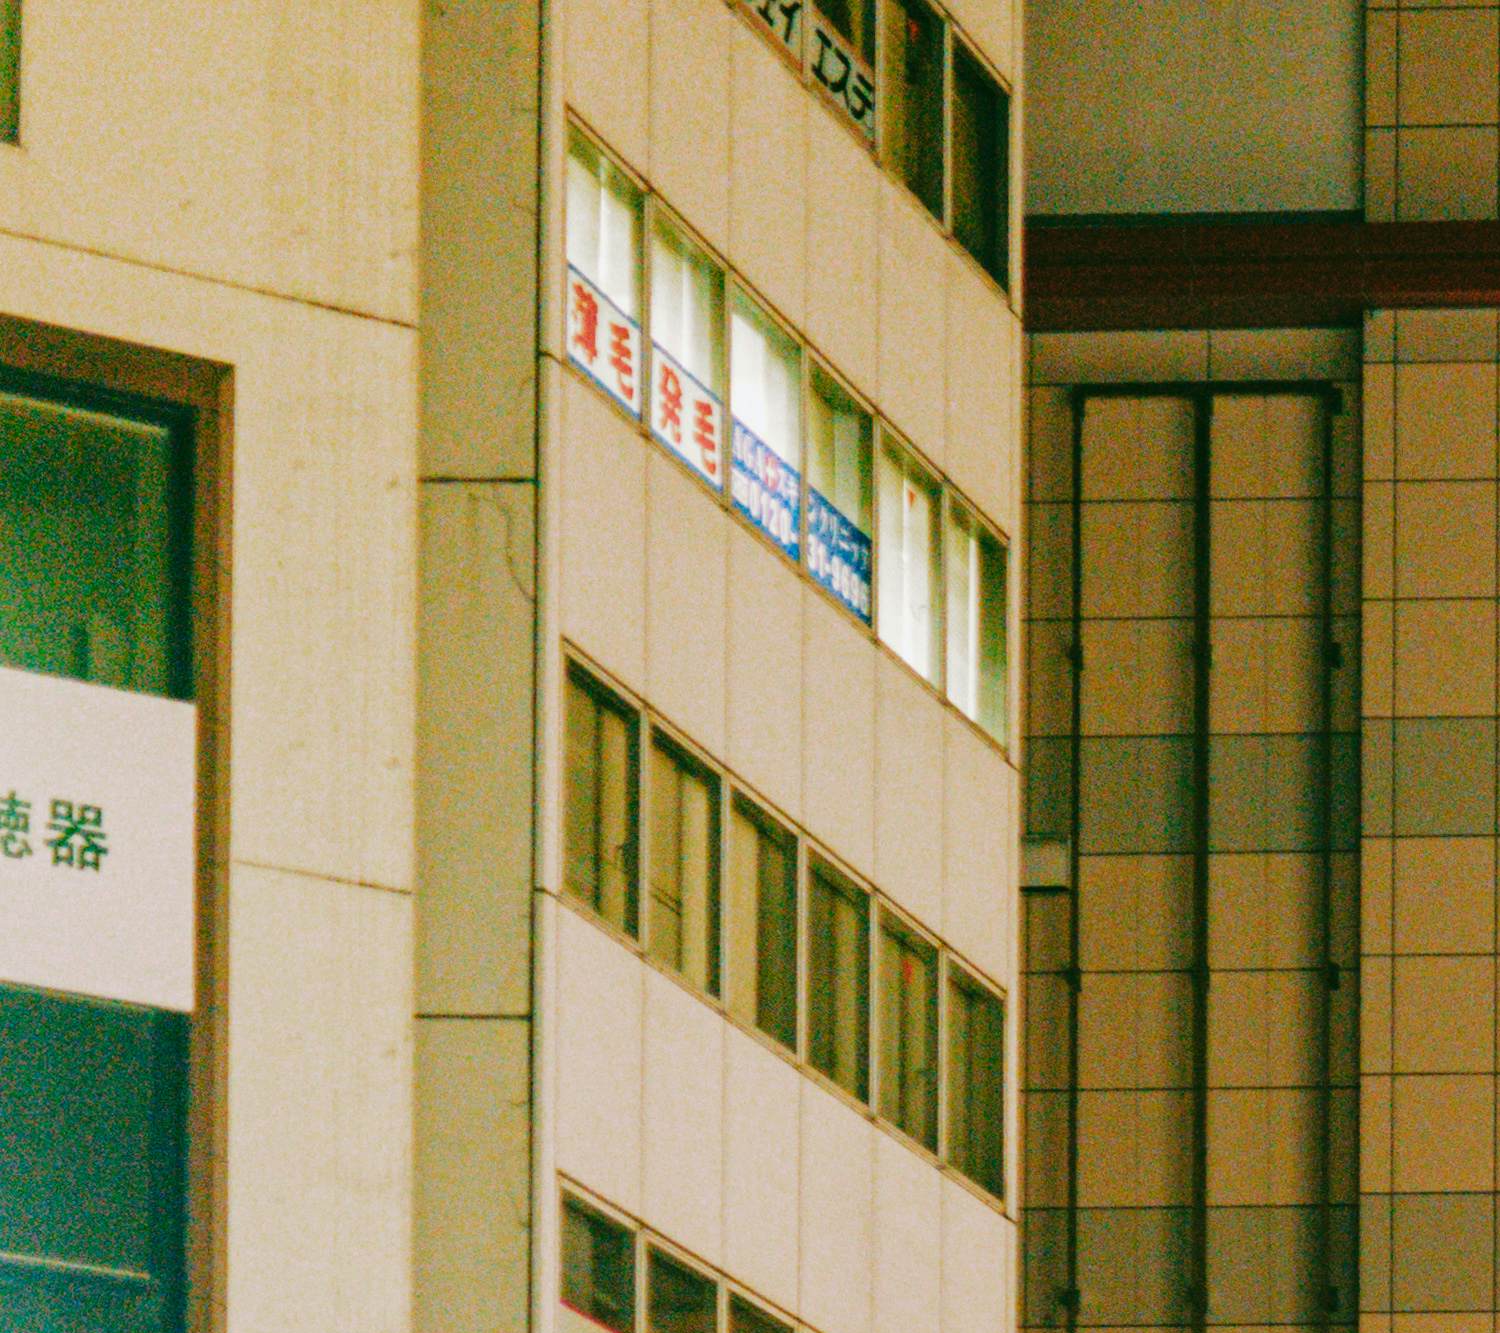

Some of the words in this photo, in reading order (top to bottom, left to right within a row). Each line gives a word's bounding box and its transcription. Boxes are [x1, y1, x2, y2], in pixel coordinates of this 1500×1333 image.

[811, 29, 876, 121] エステ
[659, 361, 717, 475] 発毛
